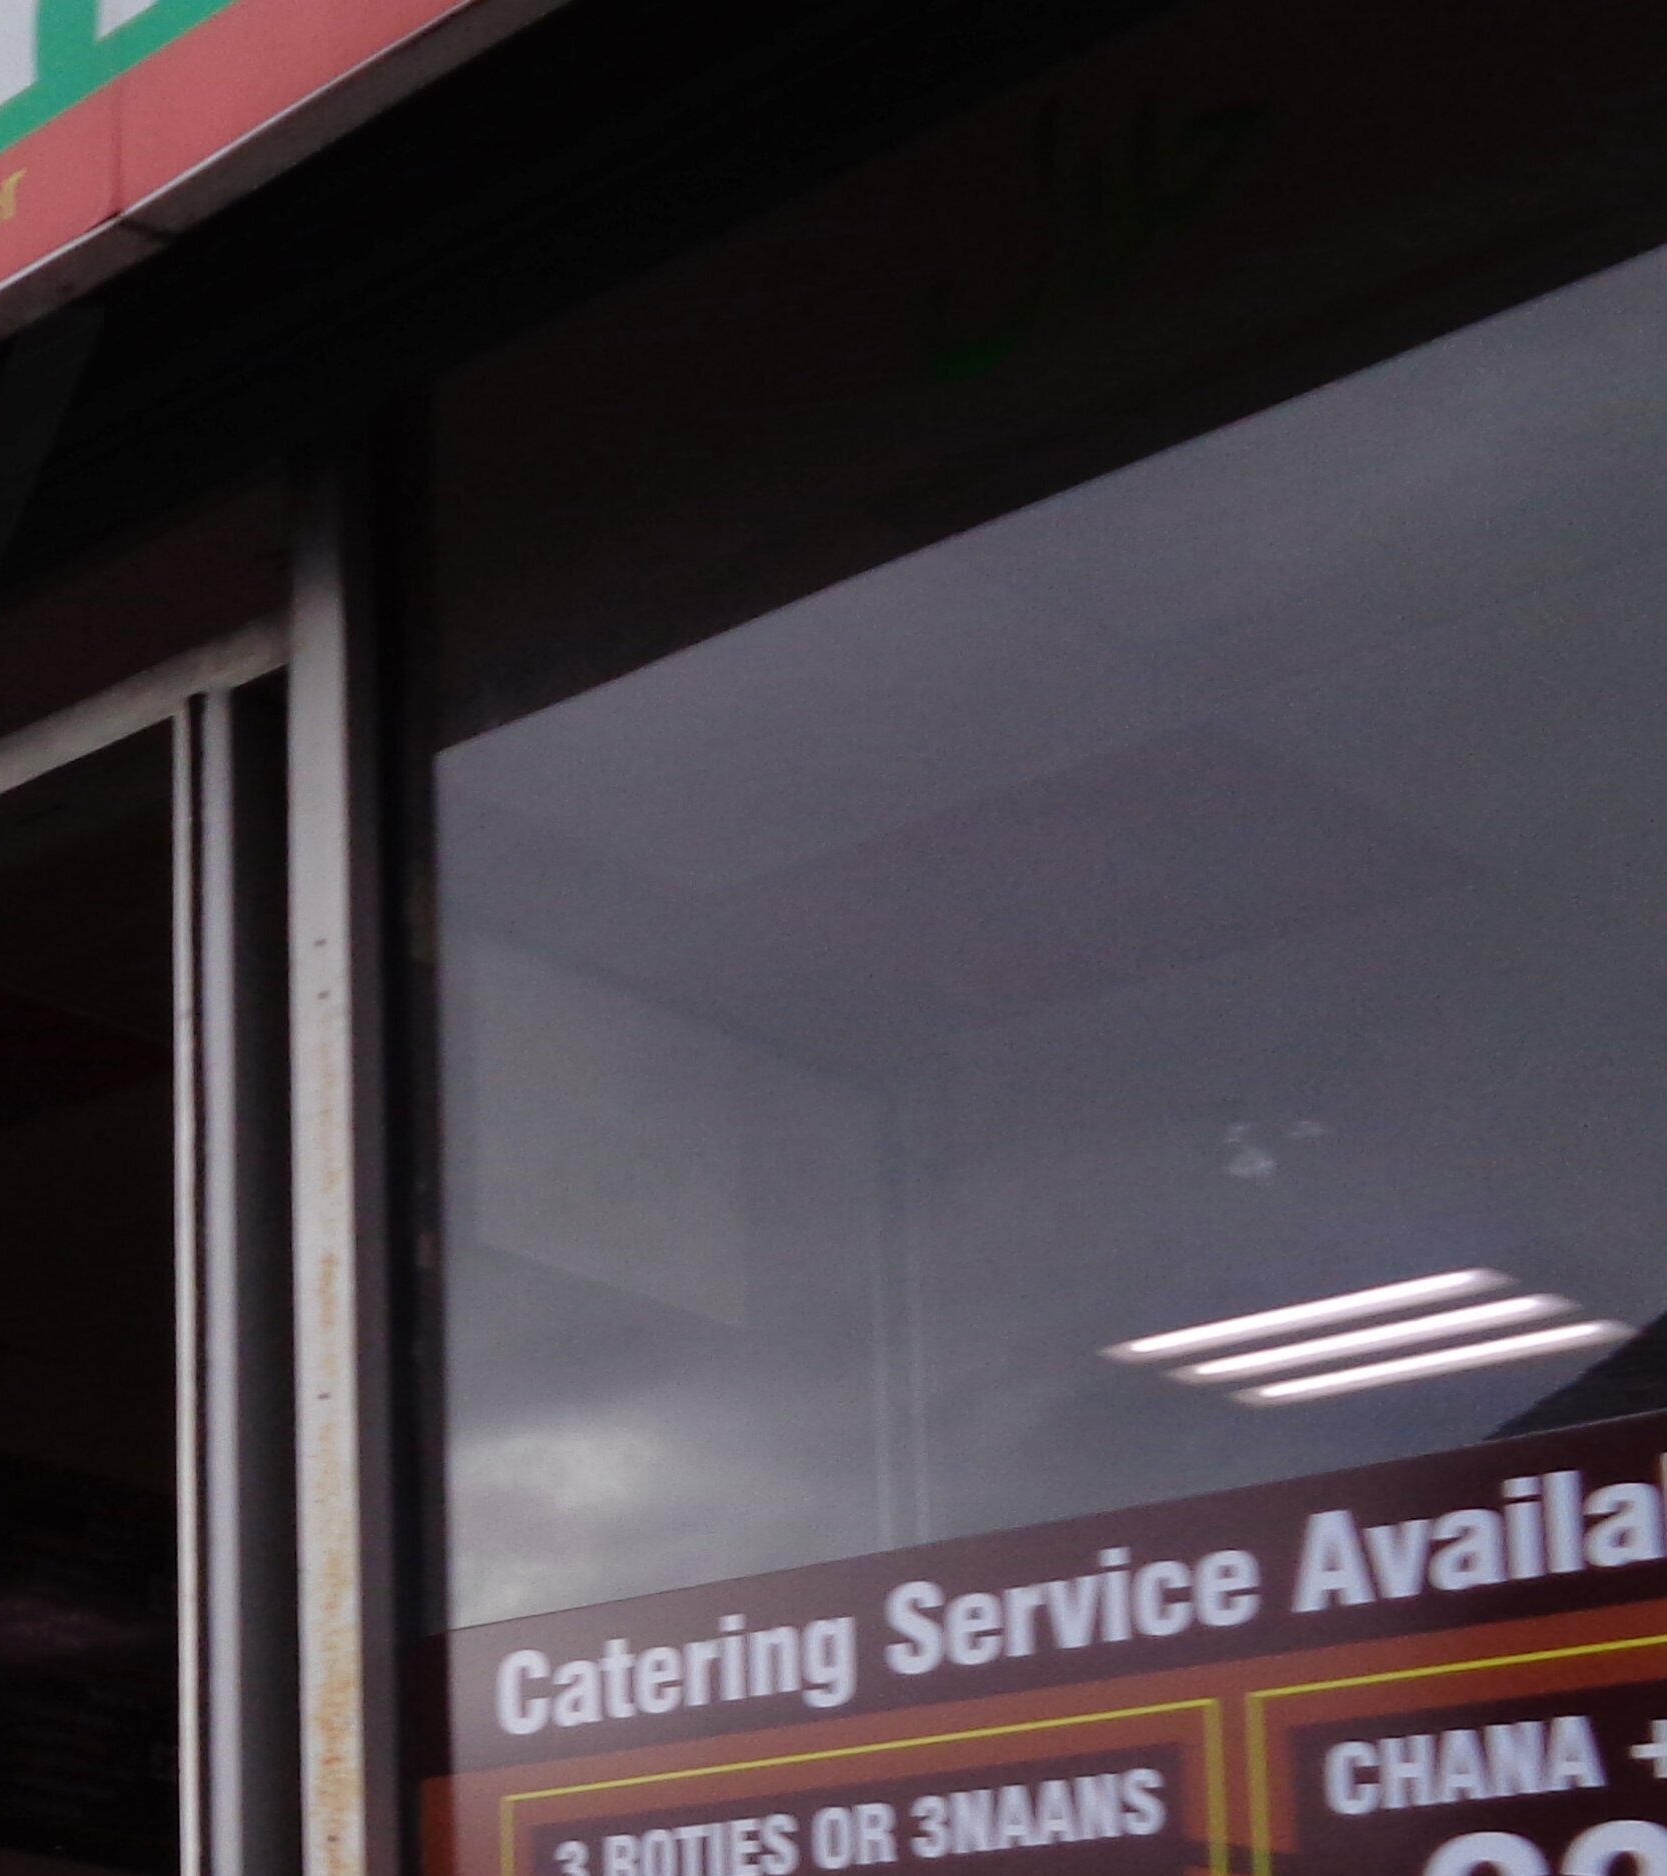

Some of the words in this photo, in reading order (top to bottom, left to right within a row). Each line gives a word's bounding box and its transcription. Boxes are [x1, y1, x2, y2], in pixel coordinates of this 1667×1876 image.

[496, 1613, 857, 1738] Catering
[884, 1543, 1258, 1679] Service
[1291, 1453, 1667, 1613] Availa
[1324, 1715, 1607, 1815] CHANA
[814, 1803, 898, 1869] OR
[912, 1766, 1165, 1858] 3NAANS
